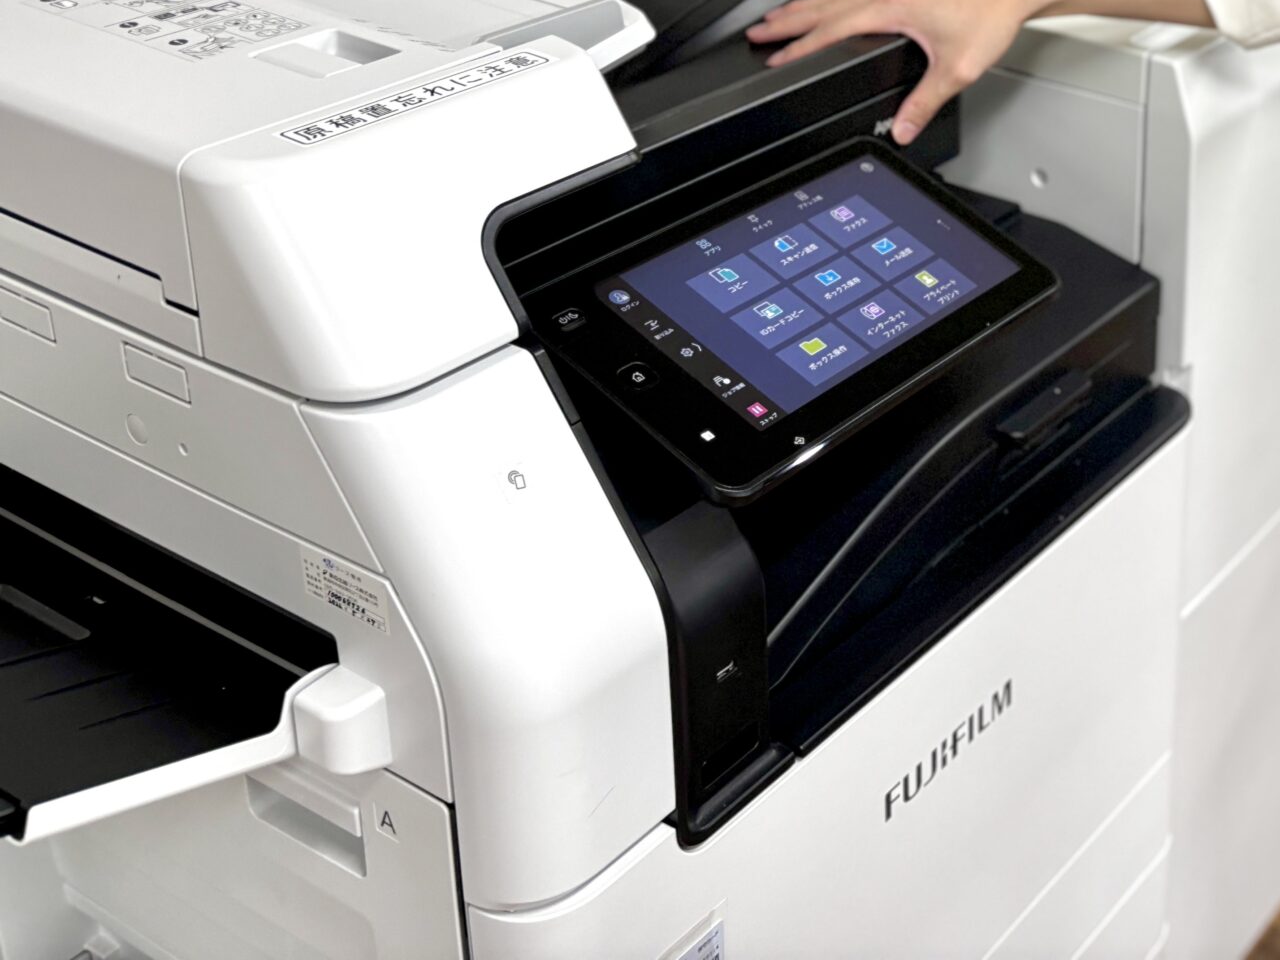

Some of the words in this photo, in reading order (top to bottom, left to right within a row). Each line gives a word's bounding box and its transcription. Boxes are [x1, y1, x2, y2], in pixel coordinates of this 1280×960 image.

[293, 55, 539, 141] 原稿置忘れに注意
[704, 245, 721, 256] アプリ
[780, 243, 819, 266] スキャン送信
[885, 247, 914, 267] メール送信
[727, 280, 749, 294] コピー
[923, 279, 957, 301] プライベート
[937, 289, 960, 305] プリント
[620, 300, 640, 313] ログイン
[759, 308, 805, 336] IDカードコピー
[866, 309, 906, 336] インターネット
[759, 412, 779, 426] ストップ
[884, 677, 1012, 823] FUJIFILM
[380, 810, 397, 836] A
